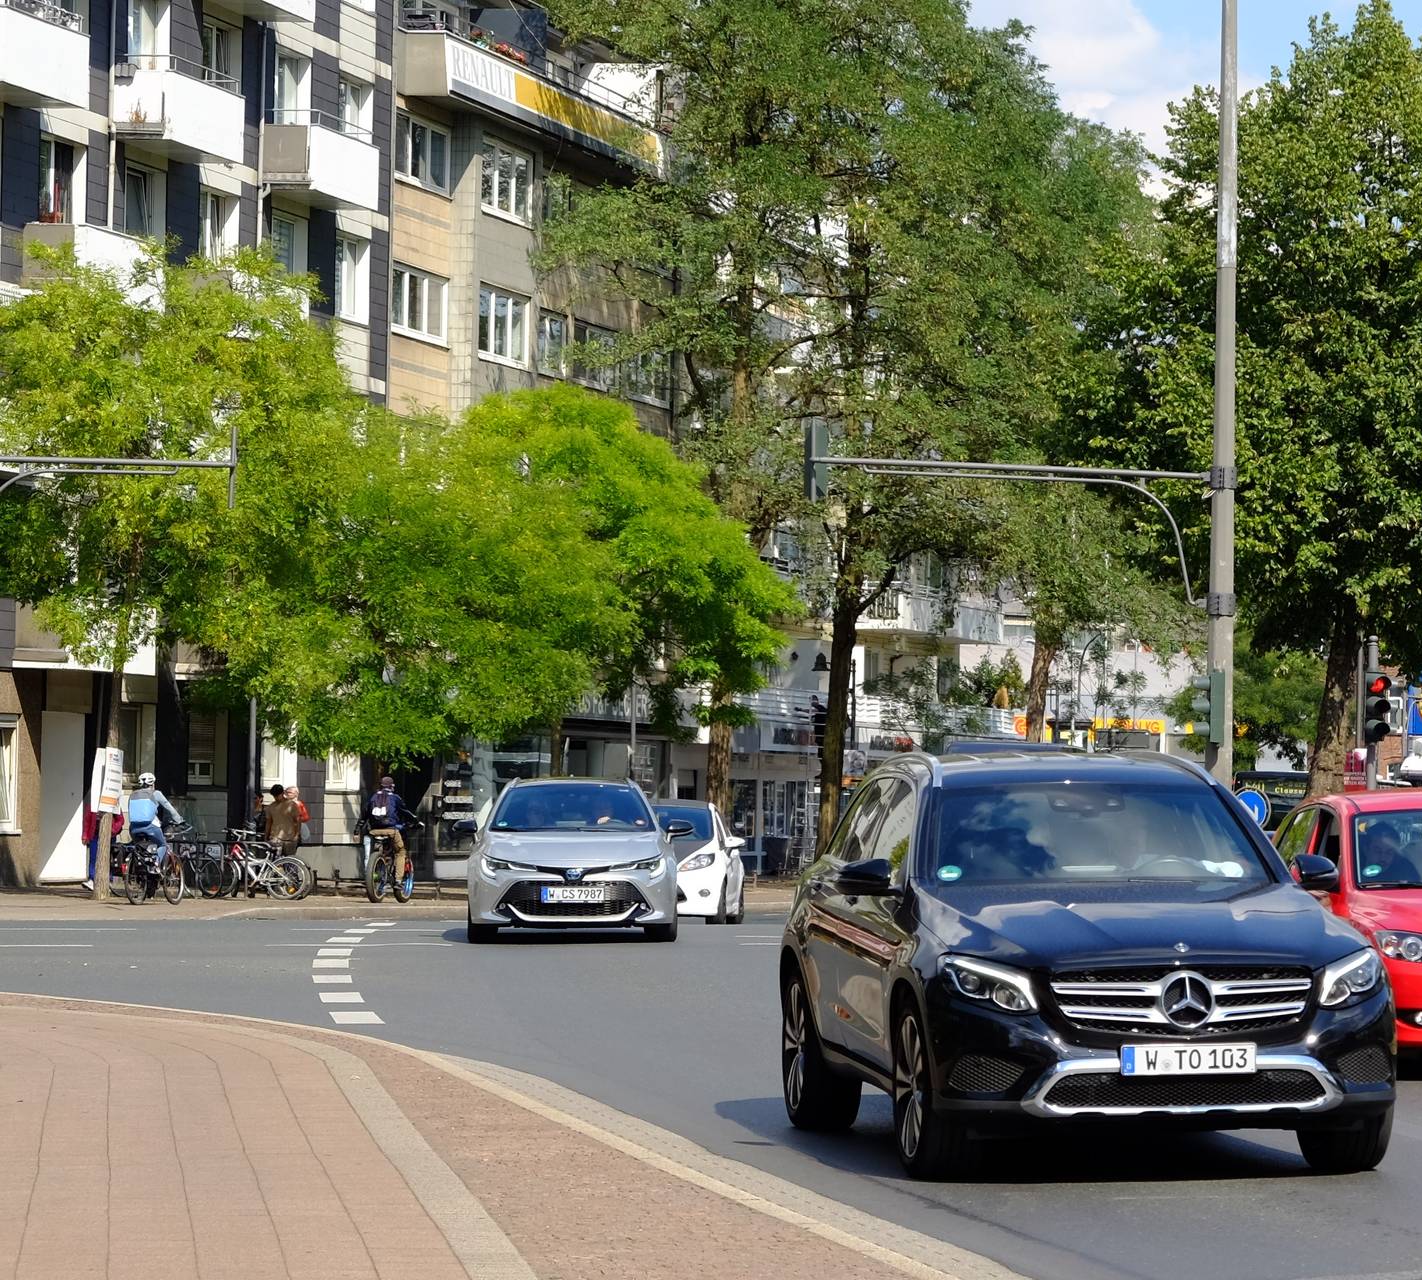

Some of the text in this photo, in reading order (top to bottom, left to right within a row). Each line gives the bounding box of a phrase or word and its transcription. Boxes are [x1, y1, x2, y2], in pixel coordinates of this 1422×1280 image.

[451, 45, 513, 100] RENAULT
[549, 889, 602, 899] W CS 7987
[1146, 1050, 1158, 1070] W
[1174, 1049, 1201, 1070] TO
[1208, 1048, 1247, 1069] 103
